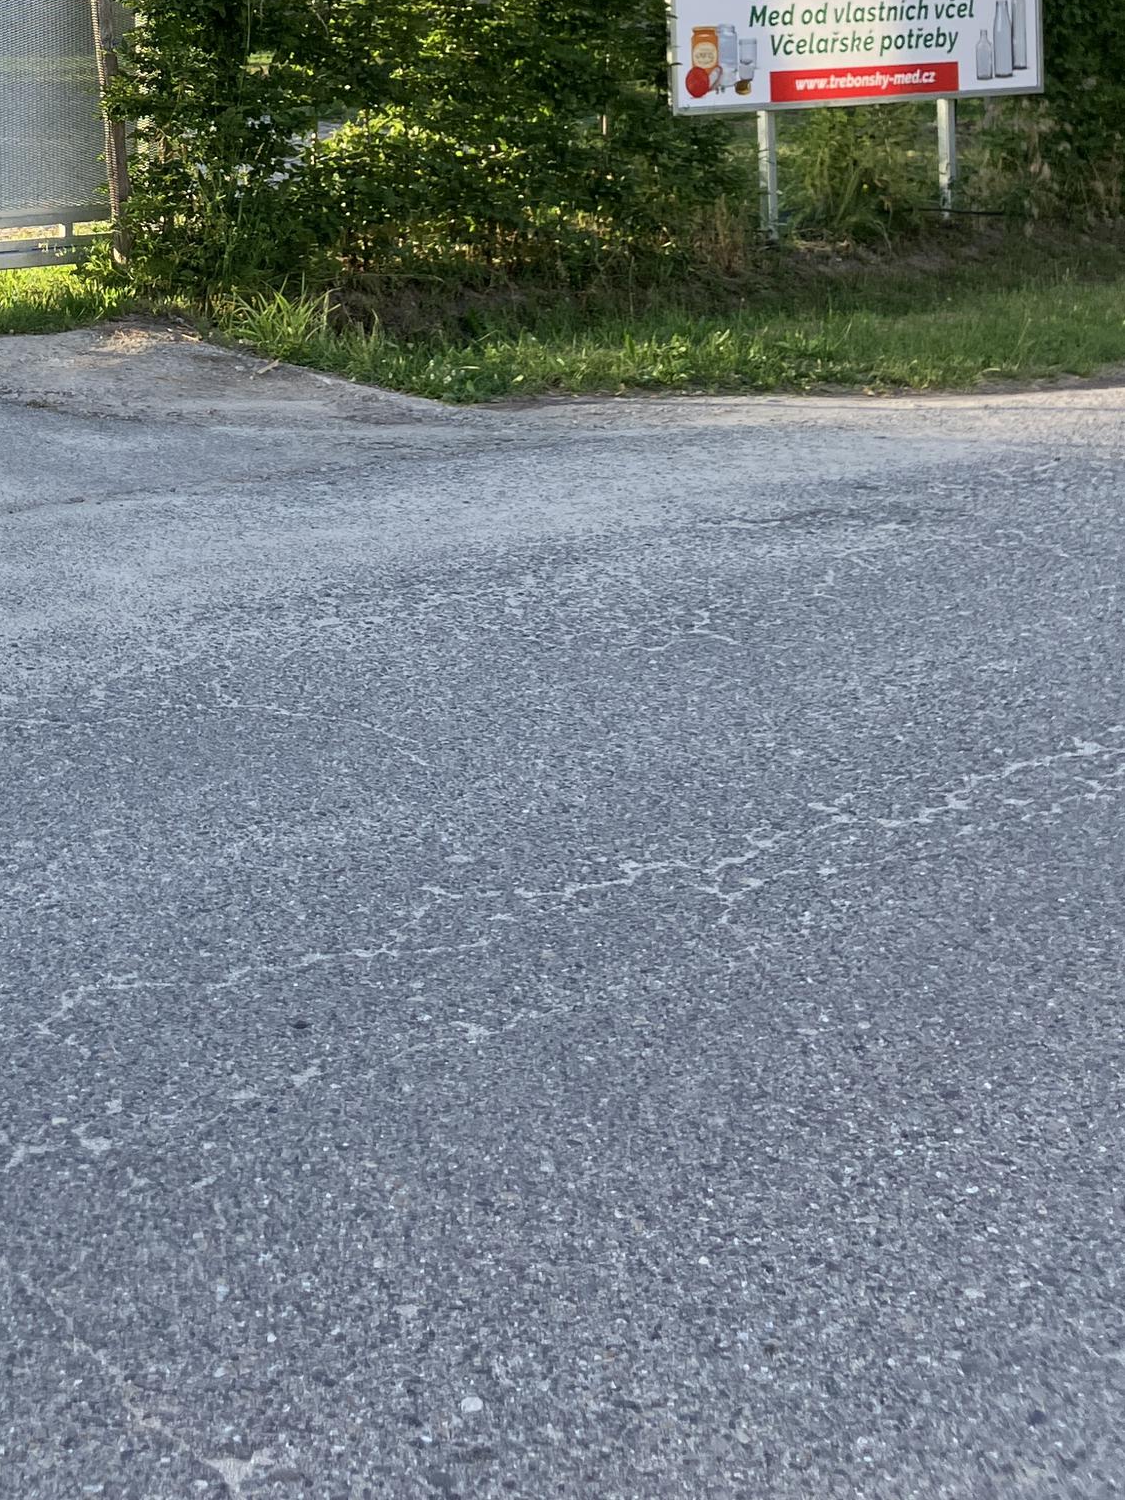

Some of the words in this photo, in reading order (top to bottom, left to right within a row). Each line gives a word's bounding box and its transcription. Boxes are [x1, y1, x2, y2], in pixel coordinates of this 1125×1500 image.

[748, 4, 795, 27] Med
[801, 2, 828, 25] od
[834, 0, 929, 24] vlastních
[770, 30, 875, 56] Včelařské
[880, 26, 959, 56] potřeby
[795, 69, 937, 91] www.trebonsky-med.cz
